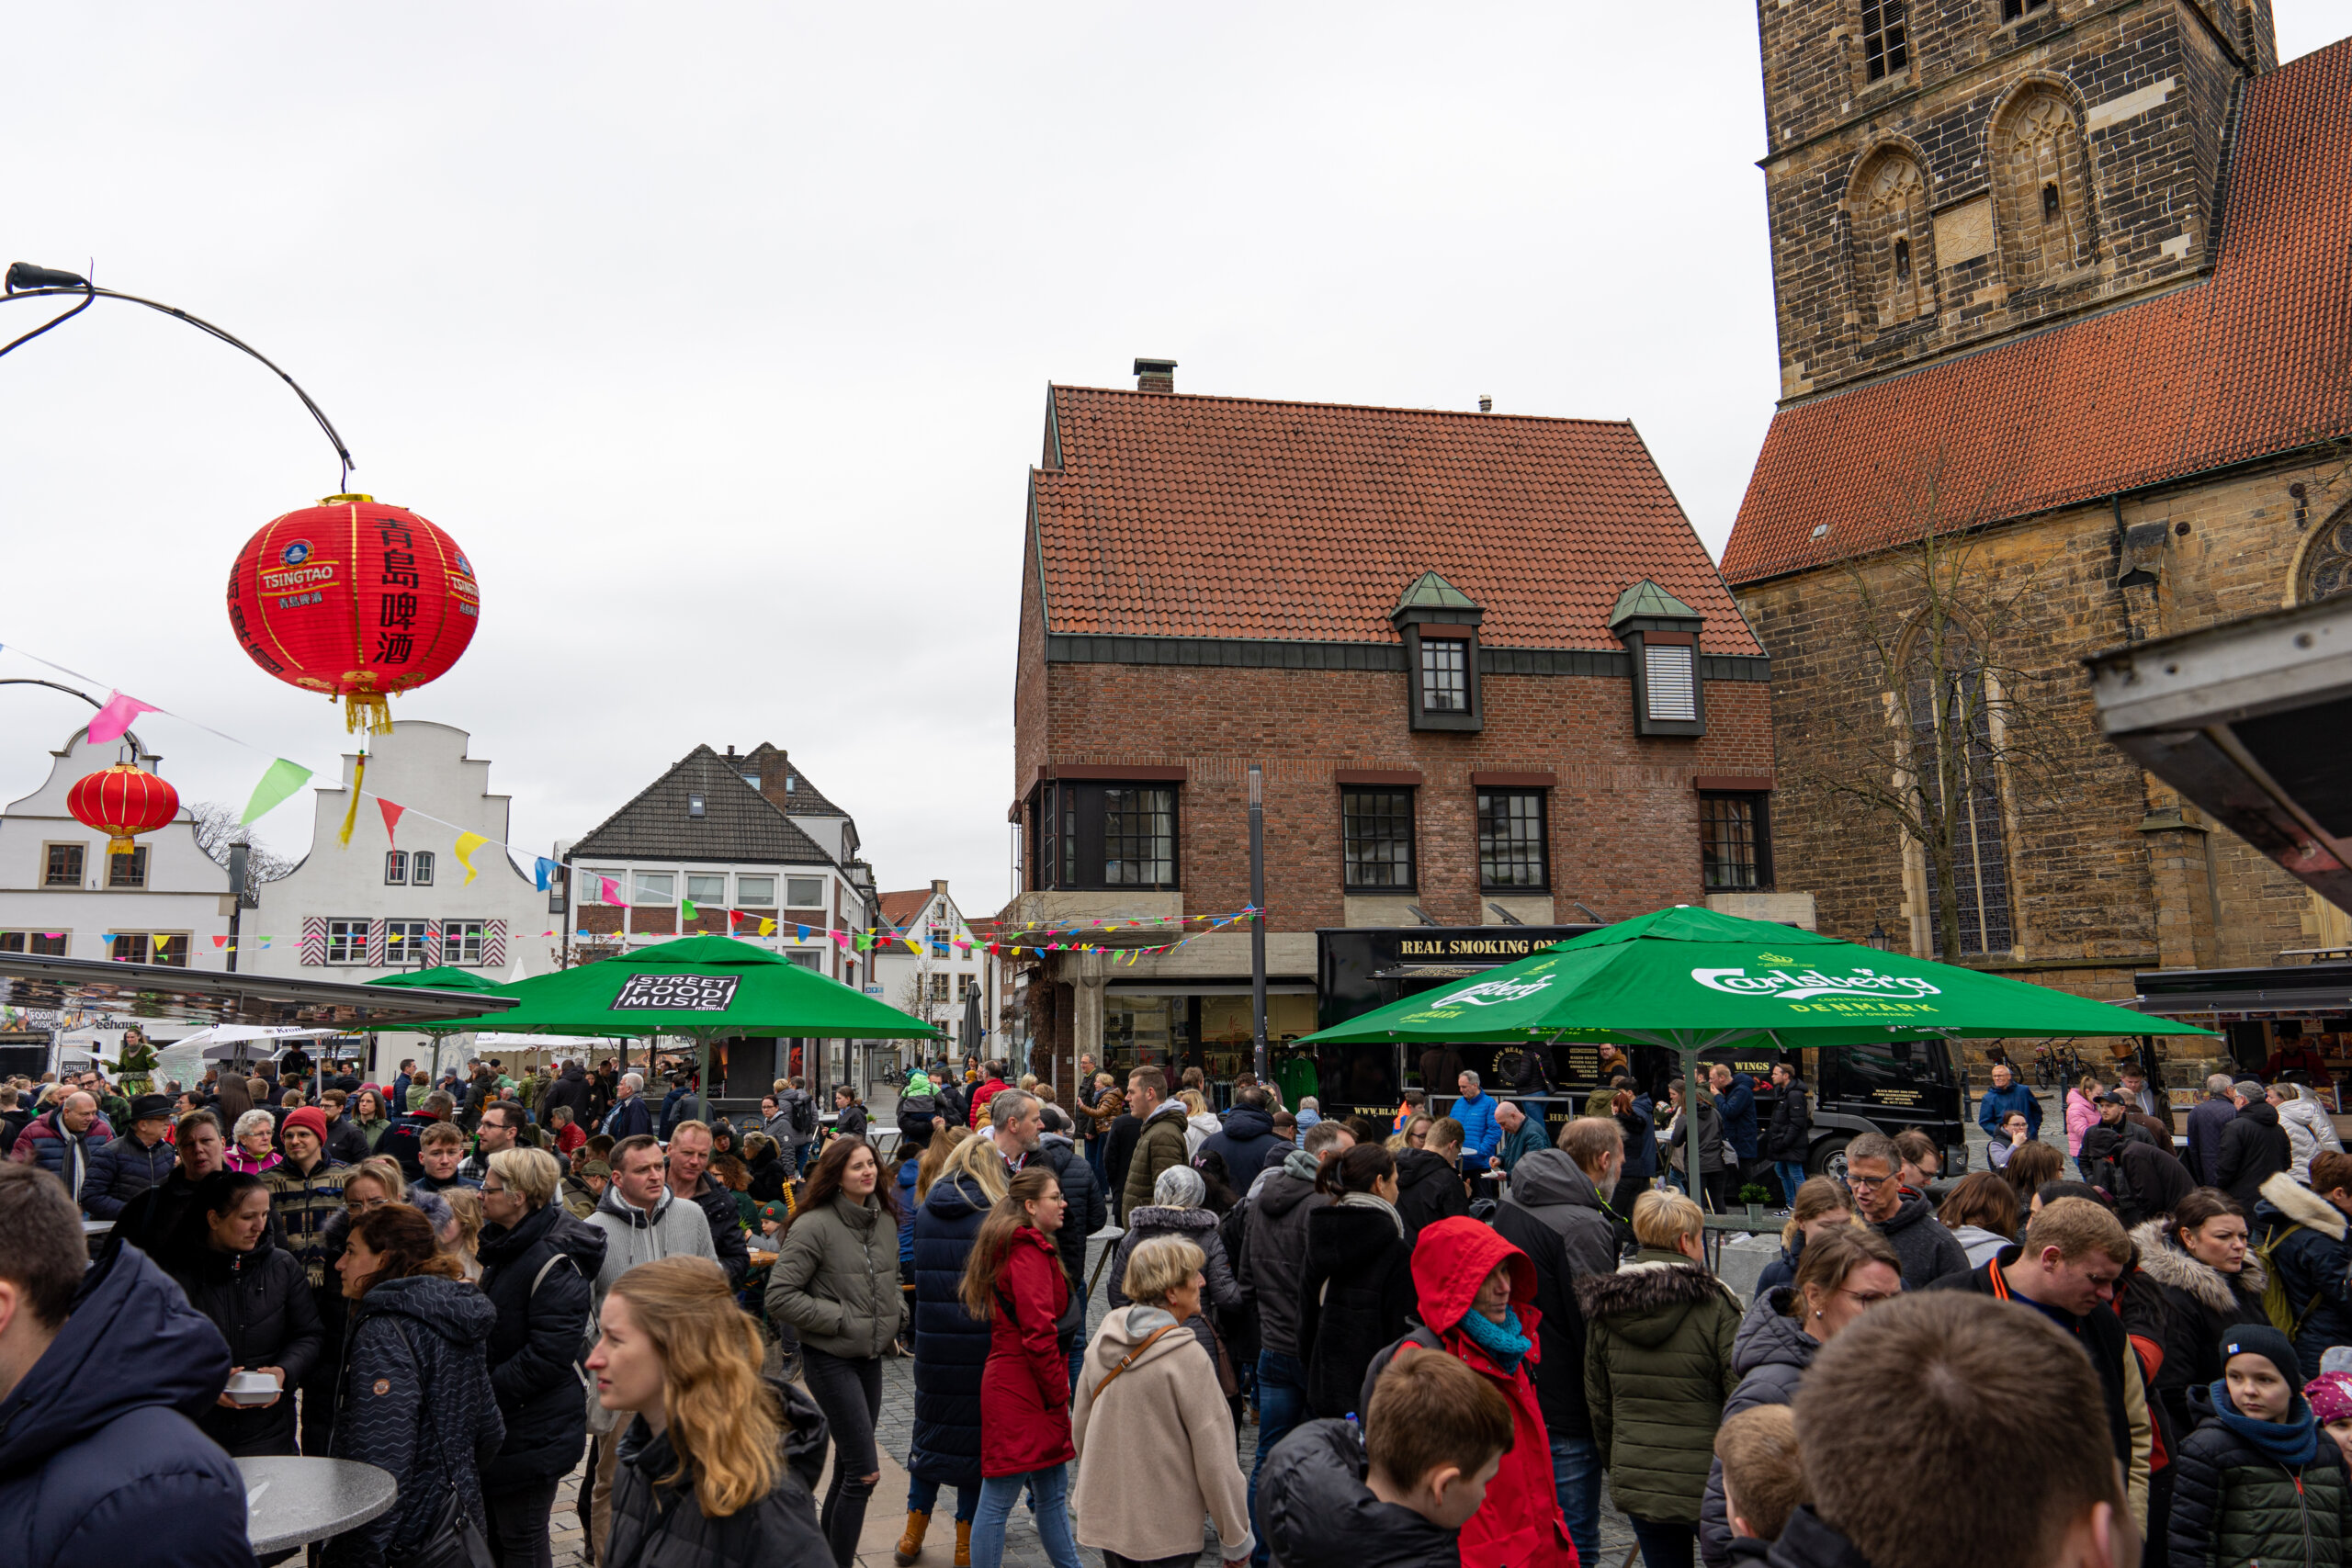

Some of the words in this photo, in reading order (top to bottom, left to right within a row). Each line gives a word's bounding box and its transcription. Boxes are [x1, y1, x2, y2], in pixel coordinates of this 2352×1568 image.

[263, 566, 333, 589] TSINGTAO
[372, 518, 419, 664] 青島啤酒
[1401, 941, 1445, 954] REAL
[1450, 940, 1529, 954] SMOKING
[637, 976, 730, 988] STREET
[1690, 967, 1942, 1000] Carlsberg
[631, 985, 723, 998] FOOD
[624, 996, 719, 1007] MUSIC
[1788, 1003, 1939, 1013] DENMARK
[30, 1011, 52, 1020] FOOD
[1735, 1061, 1770, 1071] WINGS
